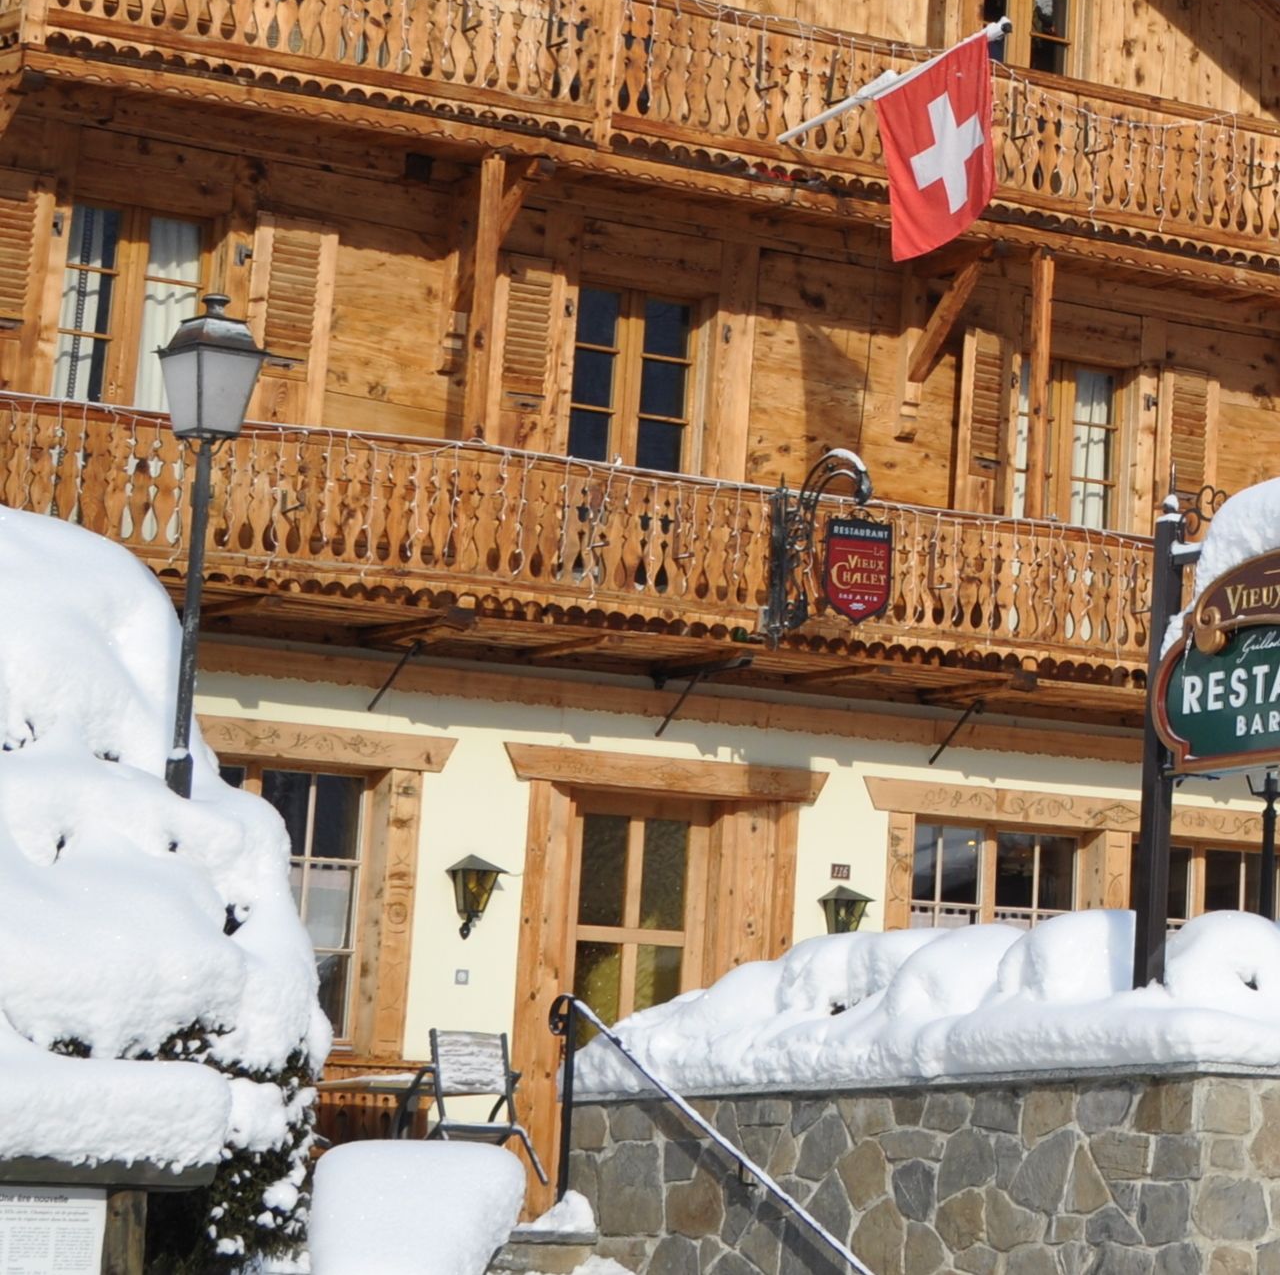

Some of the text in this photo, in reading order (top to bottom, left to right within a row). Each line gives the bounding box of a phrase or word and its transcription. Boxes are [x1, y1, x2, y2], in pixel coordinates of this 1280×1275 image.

[833, 525, 889, 539] RESTAURANT
[848, 554, 885, 571] VIEUX
[831, 561, 887, 589] CHALET
[1235, 710, 1280, 736] BAR
[832, 866, 849, 878] 116
